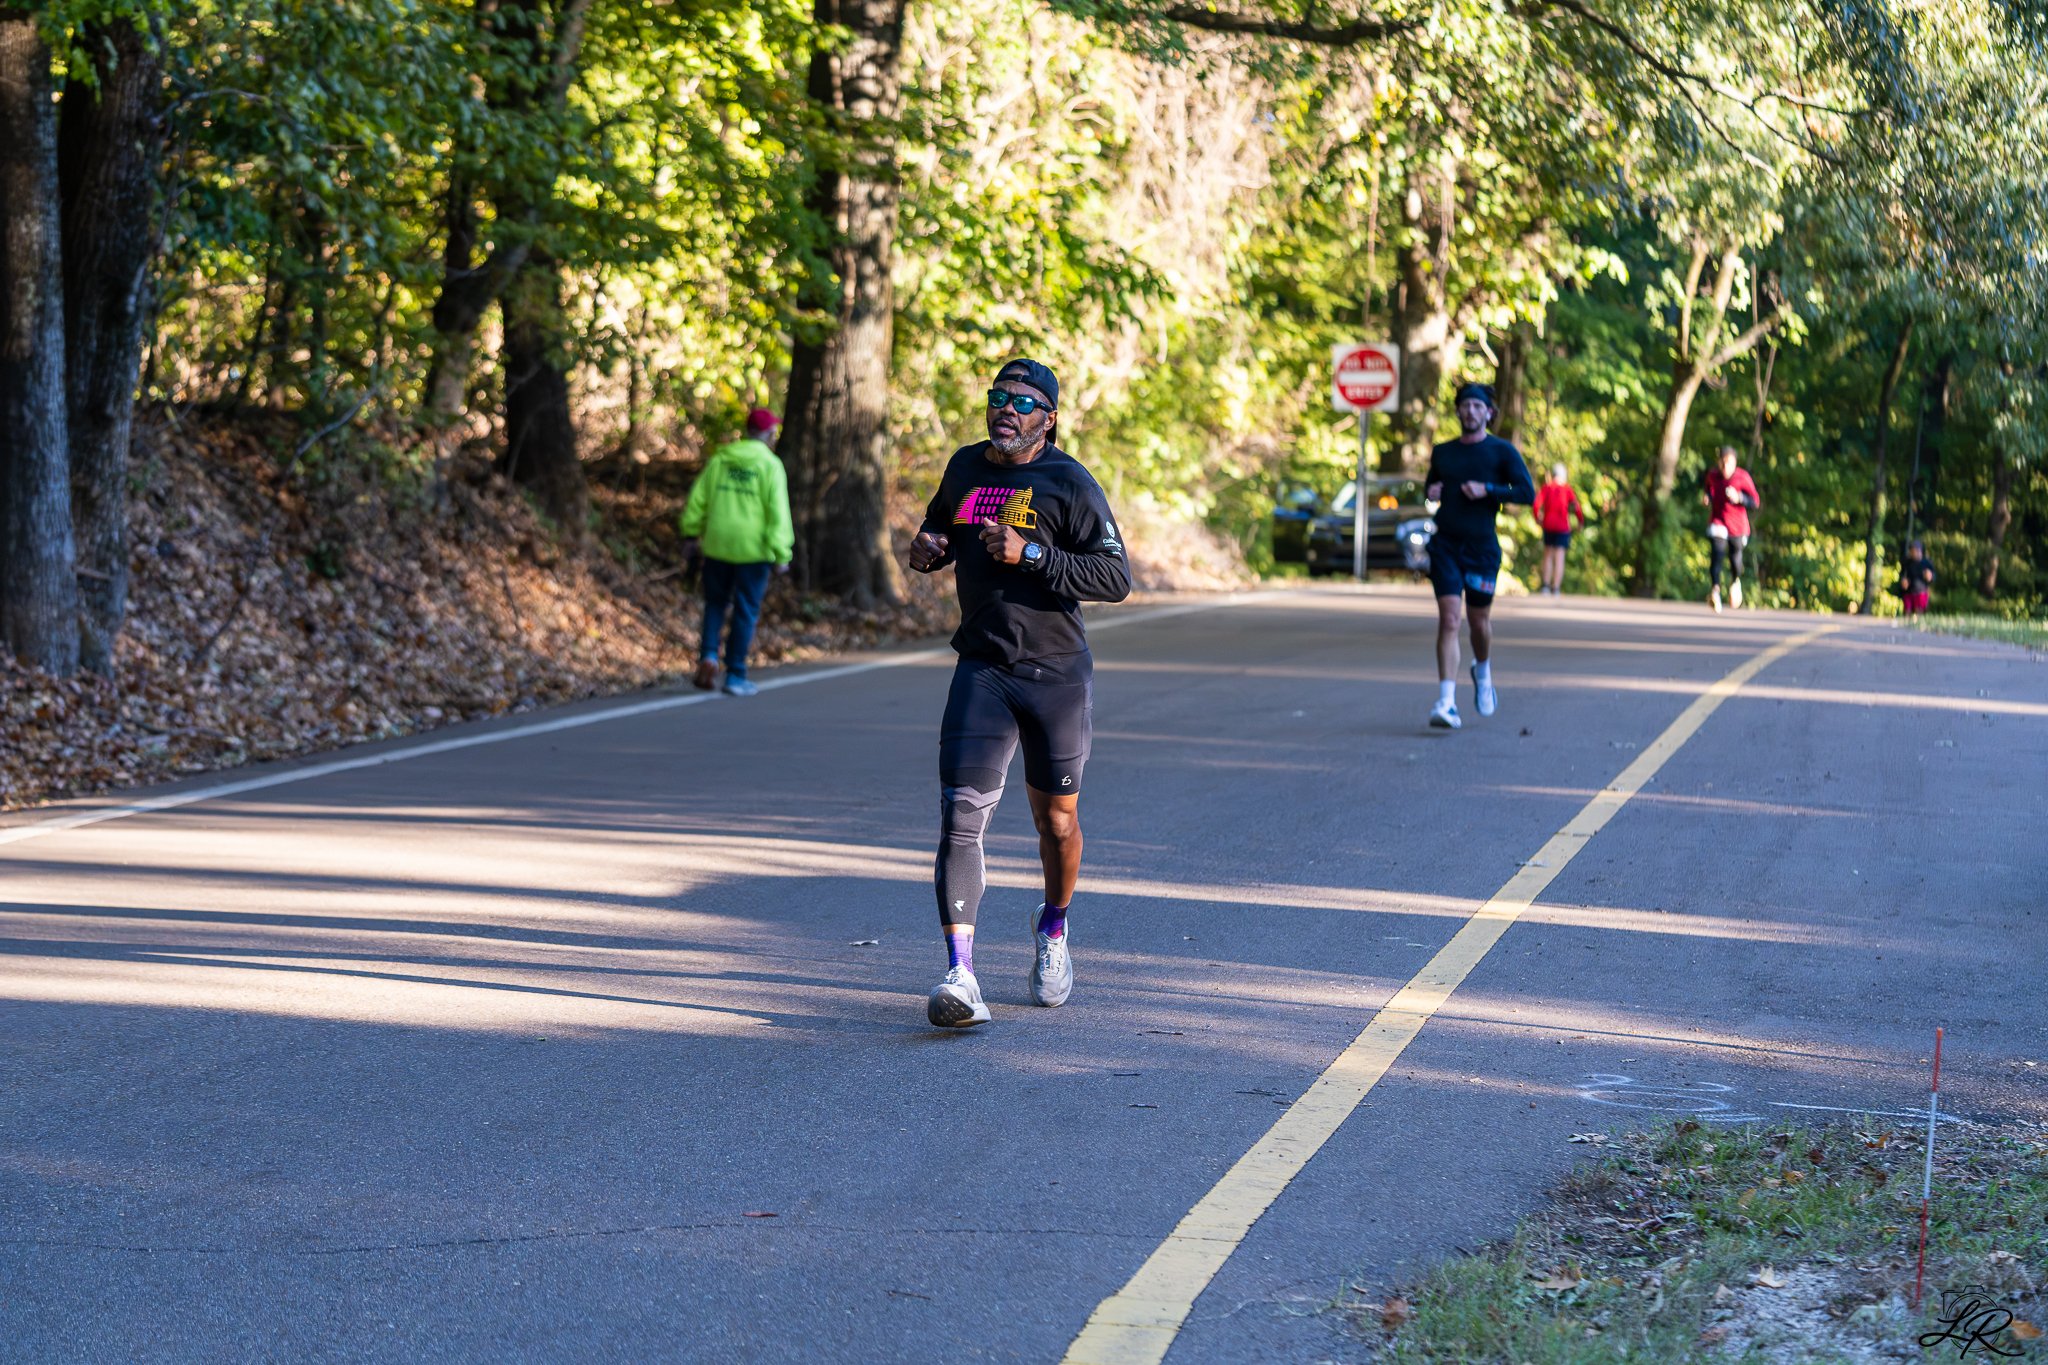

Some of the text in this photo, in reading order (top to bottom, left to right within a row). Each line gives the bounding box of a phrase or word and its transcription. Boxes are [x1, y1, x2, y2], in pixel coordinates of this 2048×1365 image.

[980, 487, 1016, 496] COOPER
[977, 496, 1006, 504] YOUNG
[974, 506, 997, 514] FOUR
[973, 515, 999, 523] MIES
